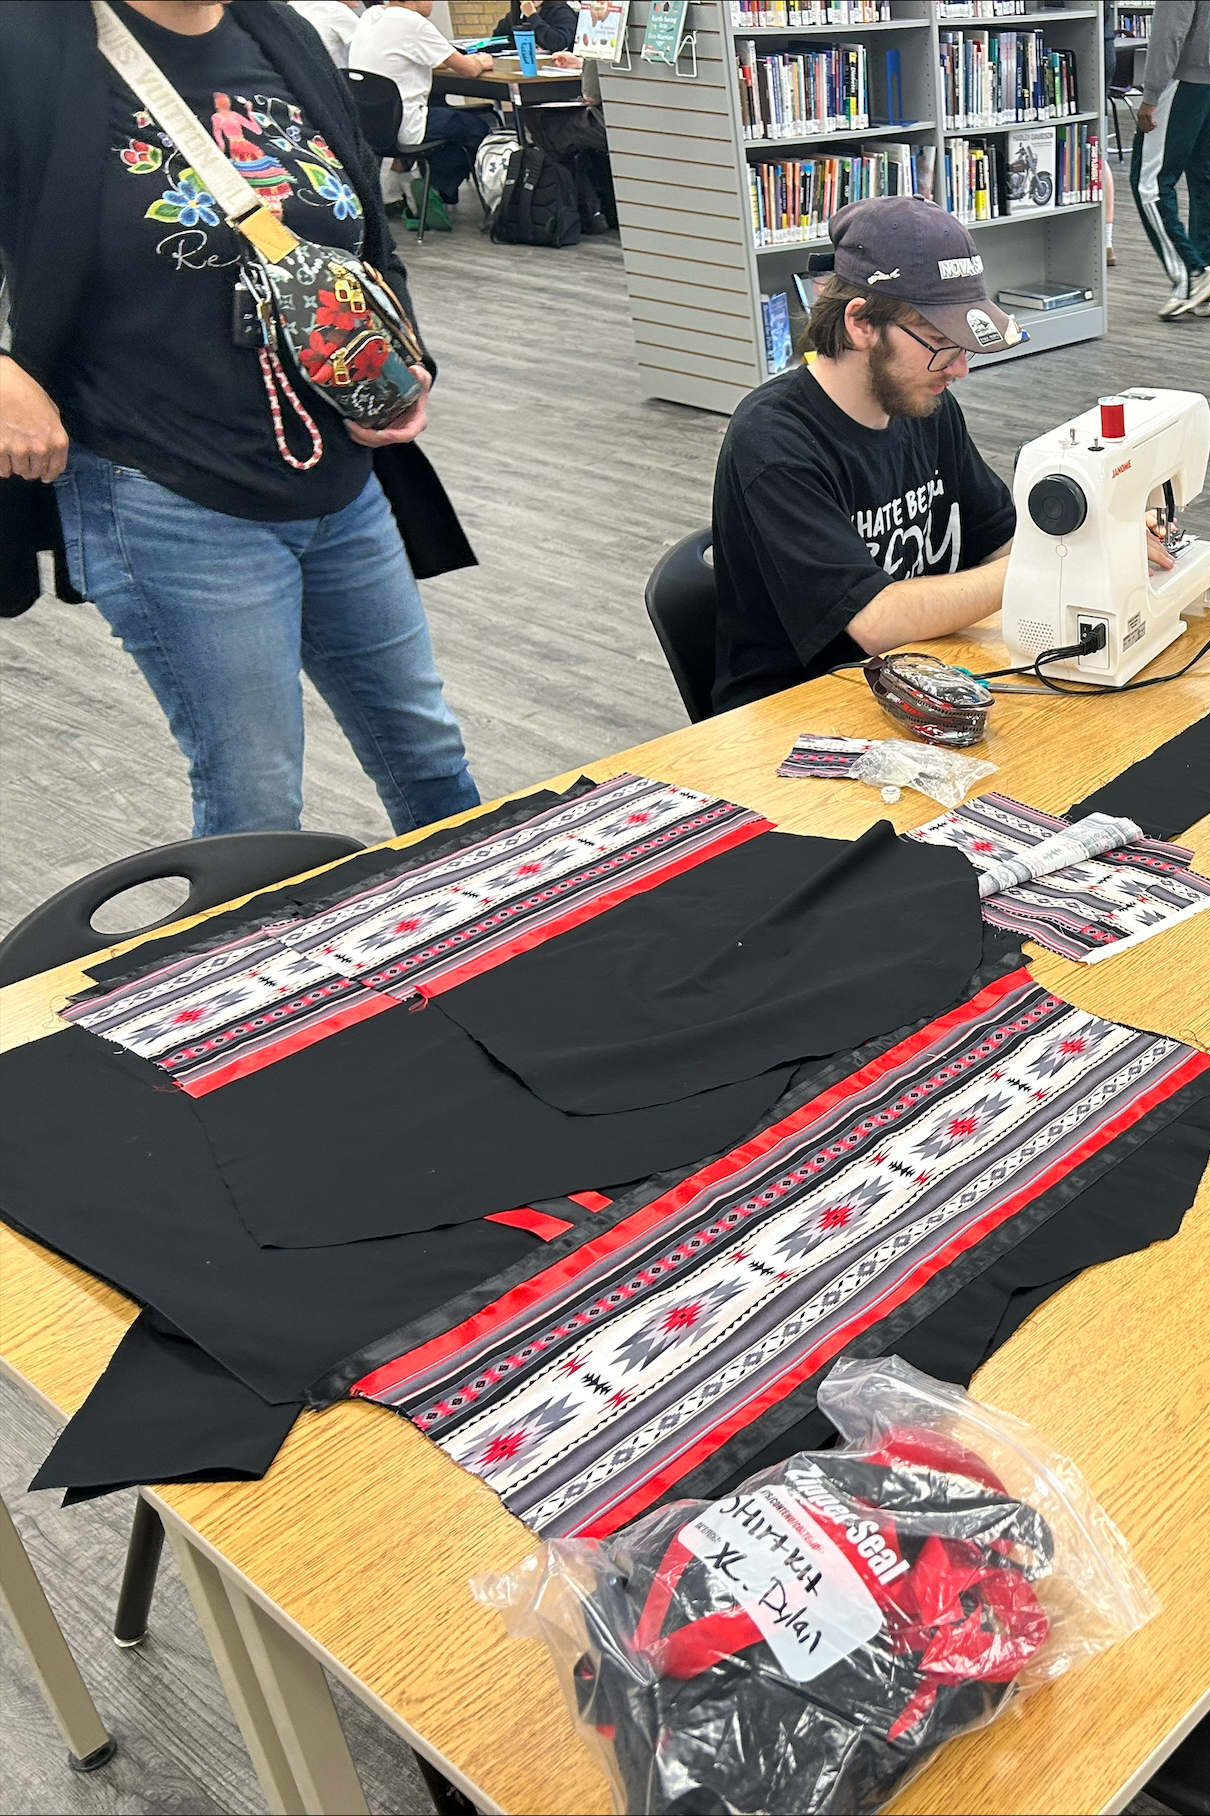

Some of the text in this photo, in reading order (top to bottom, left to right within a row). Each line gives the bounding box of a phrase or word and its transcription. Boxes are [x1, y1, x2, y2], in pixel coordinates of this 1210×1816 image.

[1112, 459, 1131, 478] JANOME
[856, 497, 904, 539] HATE
[845, 1520, 910, 1586] Seal
[758, 1576, 822, 1656] Dylan
